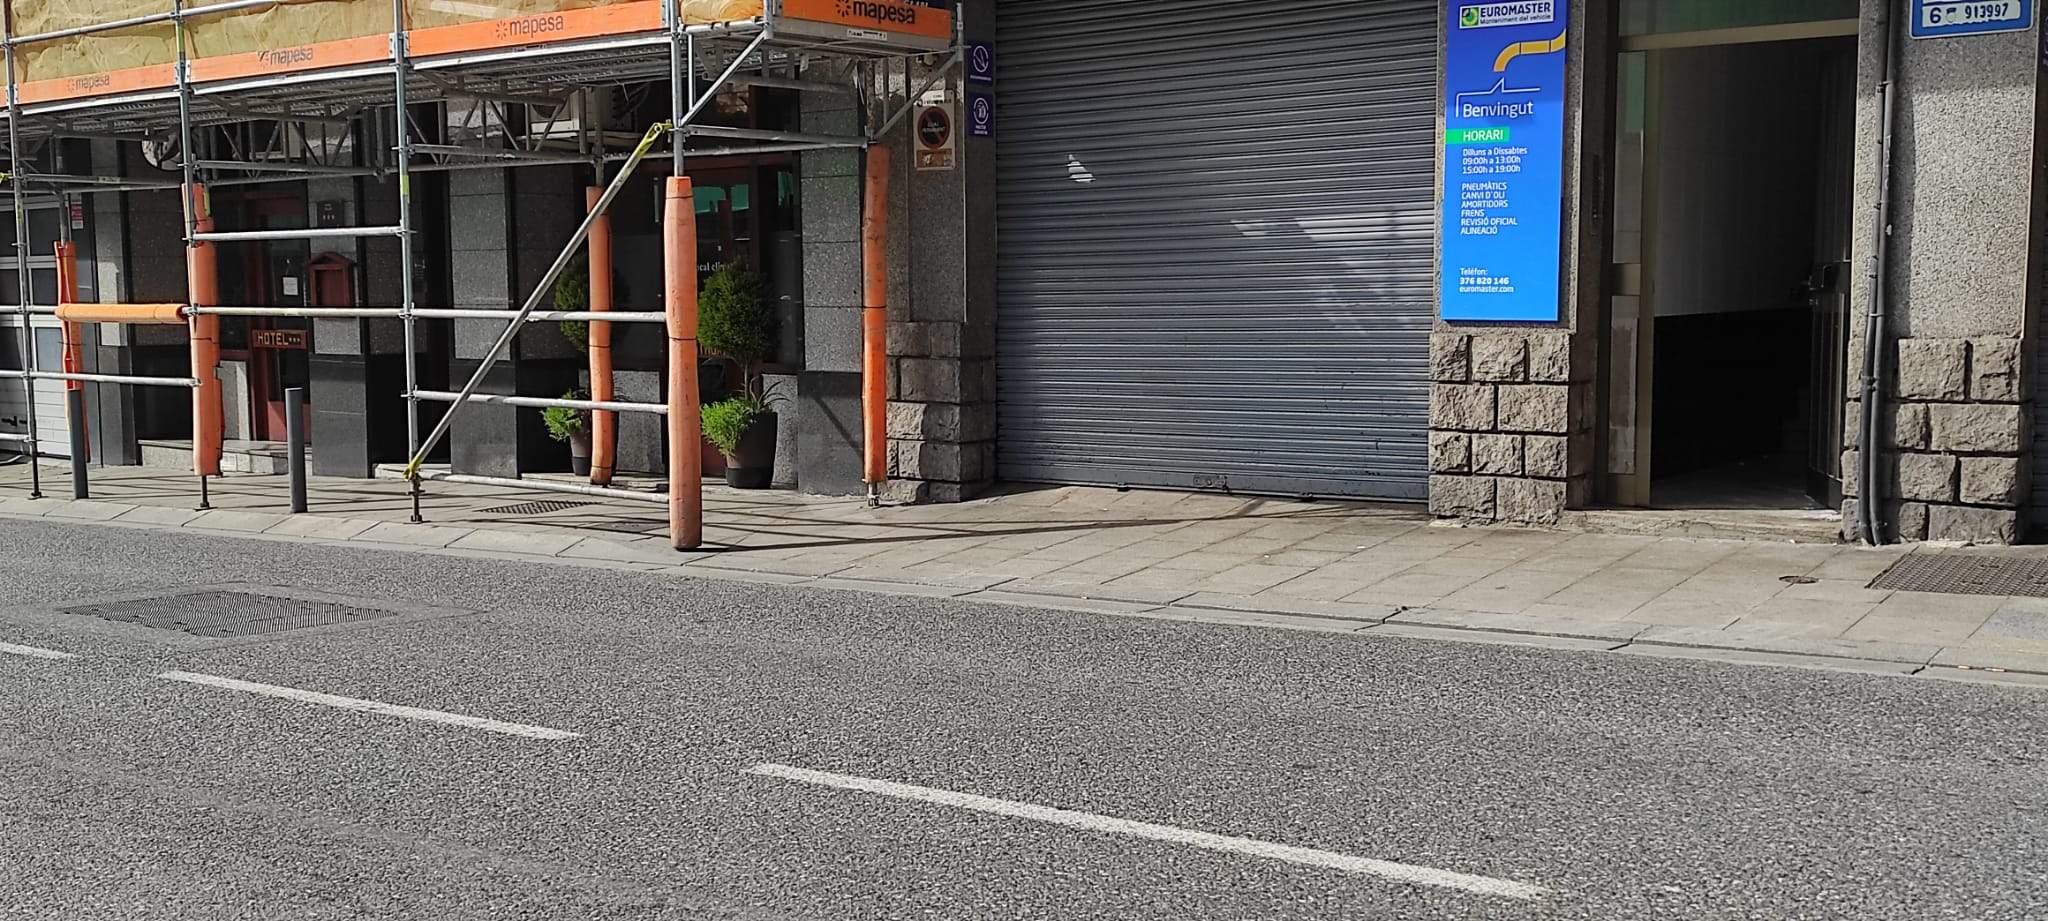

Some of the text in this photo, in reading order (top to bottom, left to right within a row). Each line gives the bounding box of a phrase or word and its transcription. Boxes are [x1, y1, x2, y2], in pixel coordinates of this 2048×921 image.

[853, 0, 916, 24] mapesa
[1480, 2, 1551, 17] EUROMASTER
[1965, 3, 2009, 19] 913997
[509, 15, 564, 38] mapesa
[270, 47, 313, 66] mapesa
[1463, 102, 1534, 118] Benvingut
[1463, 129, 1504, 142] HORARI
[1462, 148, 1486, 156] Dilluns
[1493, 147, 1528, 155] Dissabtes
[1462, 156, 1487, 165] 09:00h
[1495, 156, 1521, 164] 13:00h
[1462, 166, 1487, 174] 15:00h
[1495, 165, 1521, 173] 19:00h
[1462, 181, 1507, 191] PNEUMÀTICS
[1461, 200, 1508, 208] AMORTIDORS
[1461, 209, 1485, 217] FRENS
[1461, 216, 1518, 226] REVISIÓ OFICIAL
[1460, 225, 1498, 235] ALINEACIÓ
[1459, 277, 1510, 285] 376 820 146
[1459, 285, 1515, 293] euromaster.com
[257, 332, 289, 345] HOTEL
